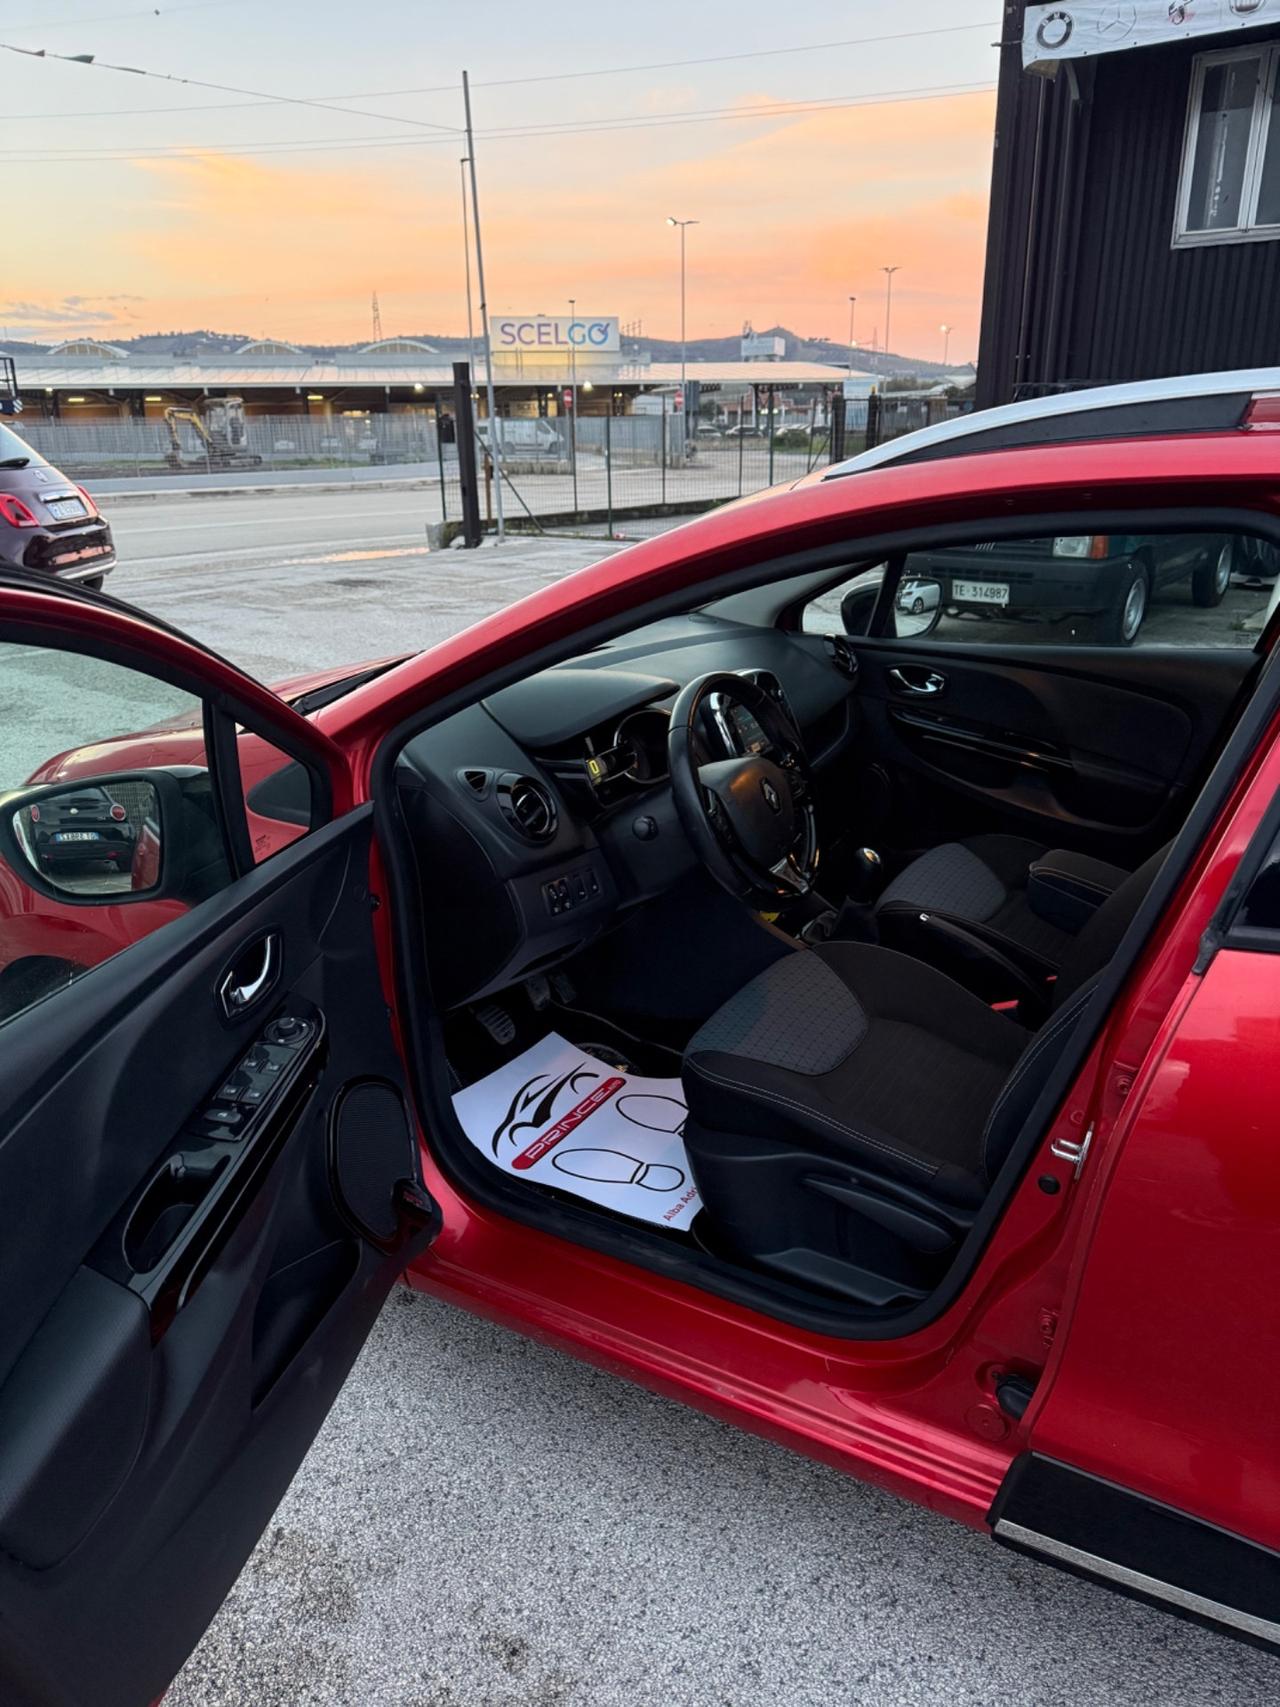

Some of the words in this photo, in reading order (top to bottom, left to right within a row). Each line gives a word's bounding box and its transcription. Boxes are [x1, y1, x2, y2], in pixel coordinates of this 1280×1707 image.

[500, 322, 610, 346] SCELGO
[525, 1088, 612, 1160] PRINCE
[663, 1198, 685, 1222] Alba
